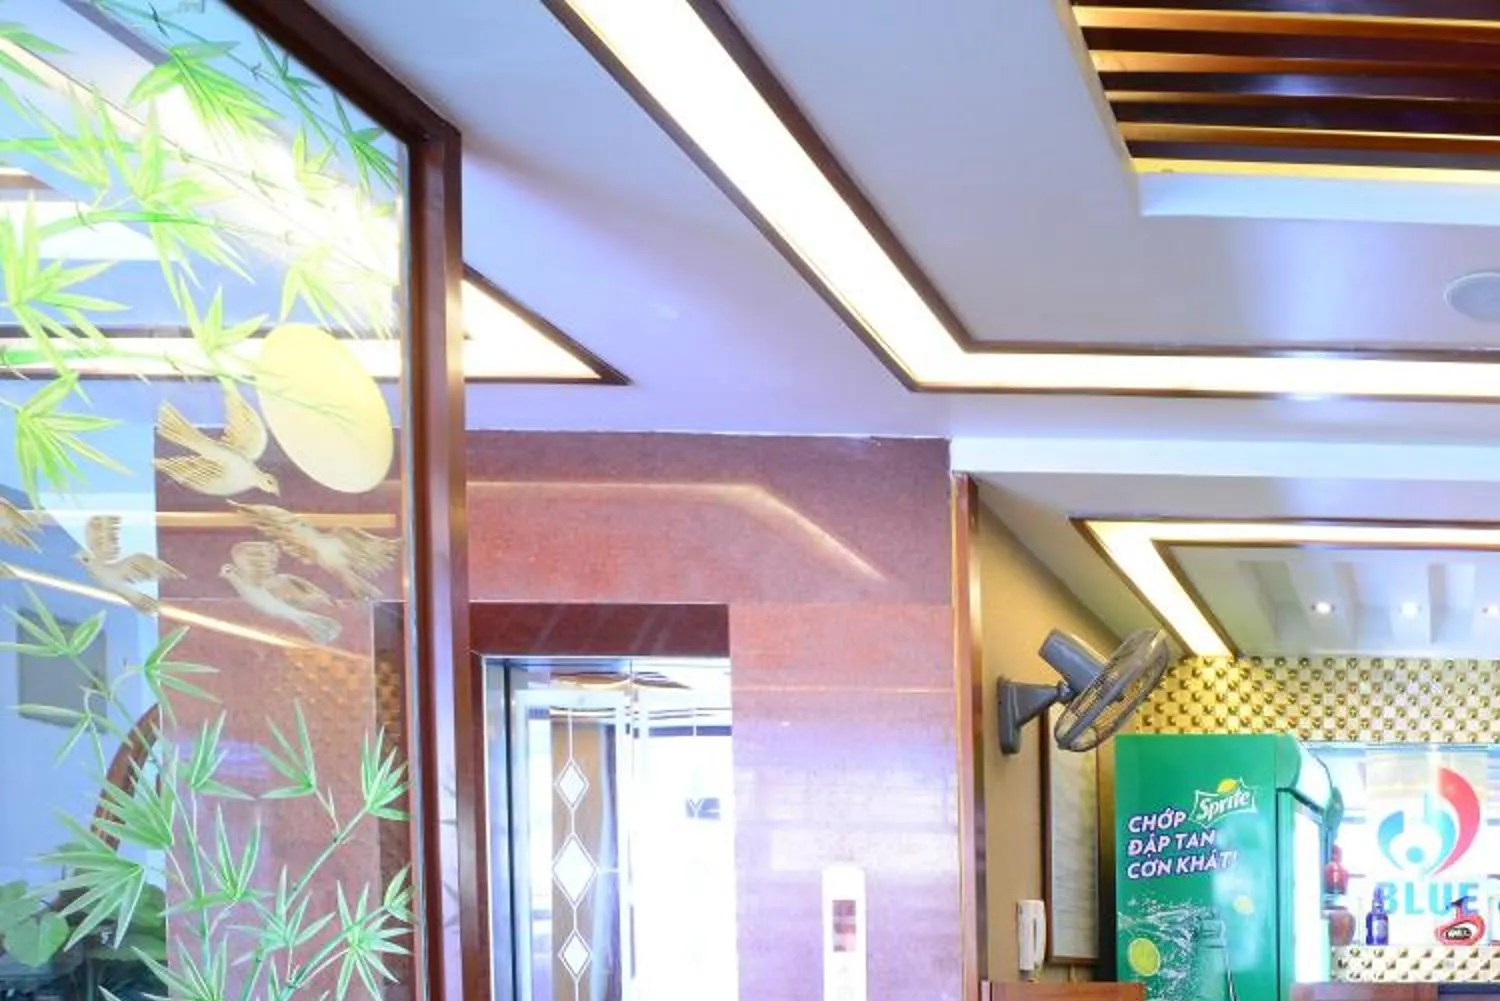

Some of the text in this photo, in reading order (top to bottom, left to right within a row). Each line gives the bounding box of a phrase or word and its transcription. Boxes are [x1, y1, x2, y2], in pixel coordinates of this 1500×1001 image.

[1197, 787, 1250, 821] Sprite
[1128, 807, 1187, 834] CHỚP
[1176, 830, 1216, 850] TAN
[1127, 857, 1173, 880] CƠN
[1376, 881, 1479, 915] BLUE
